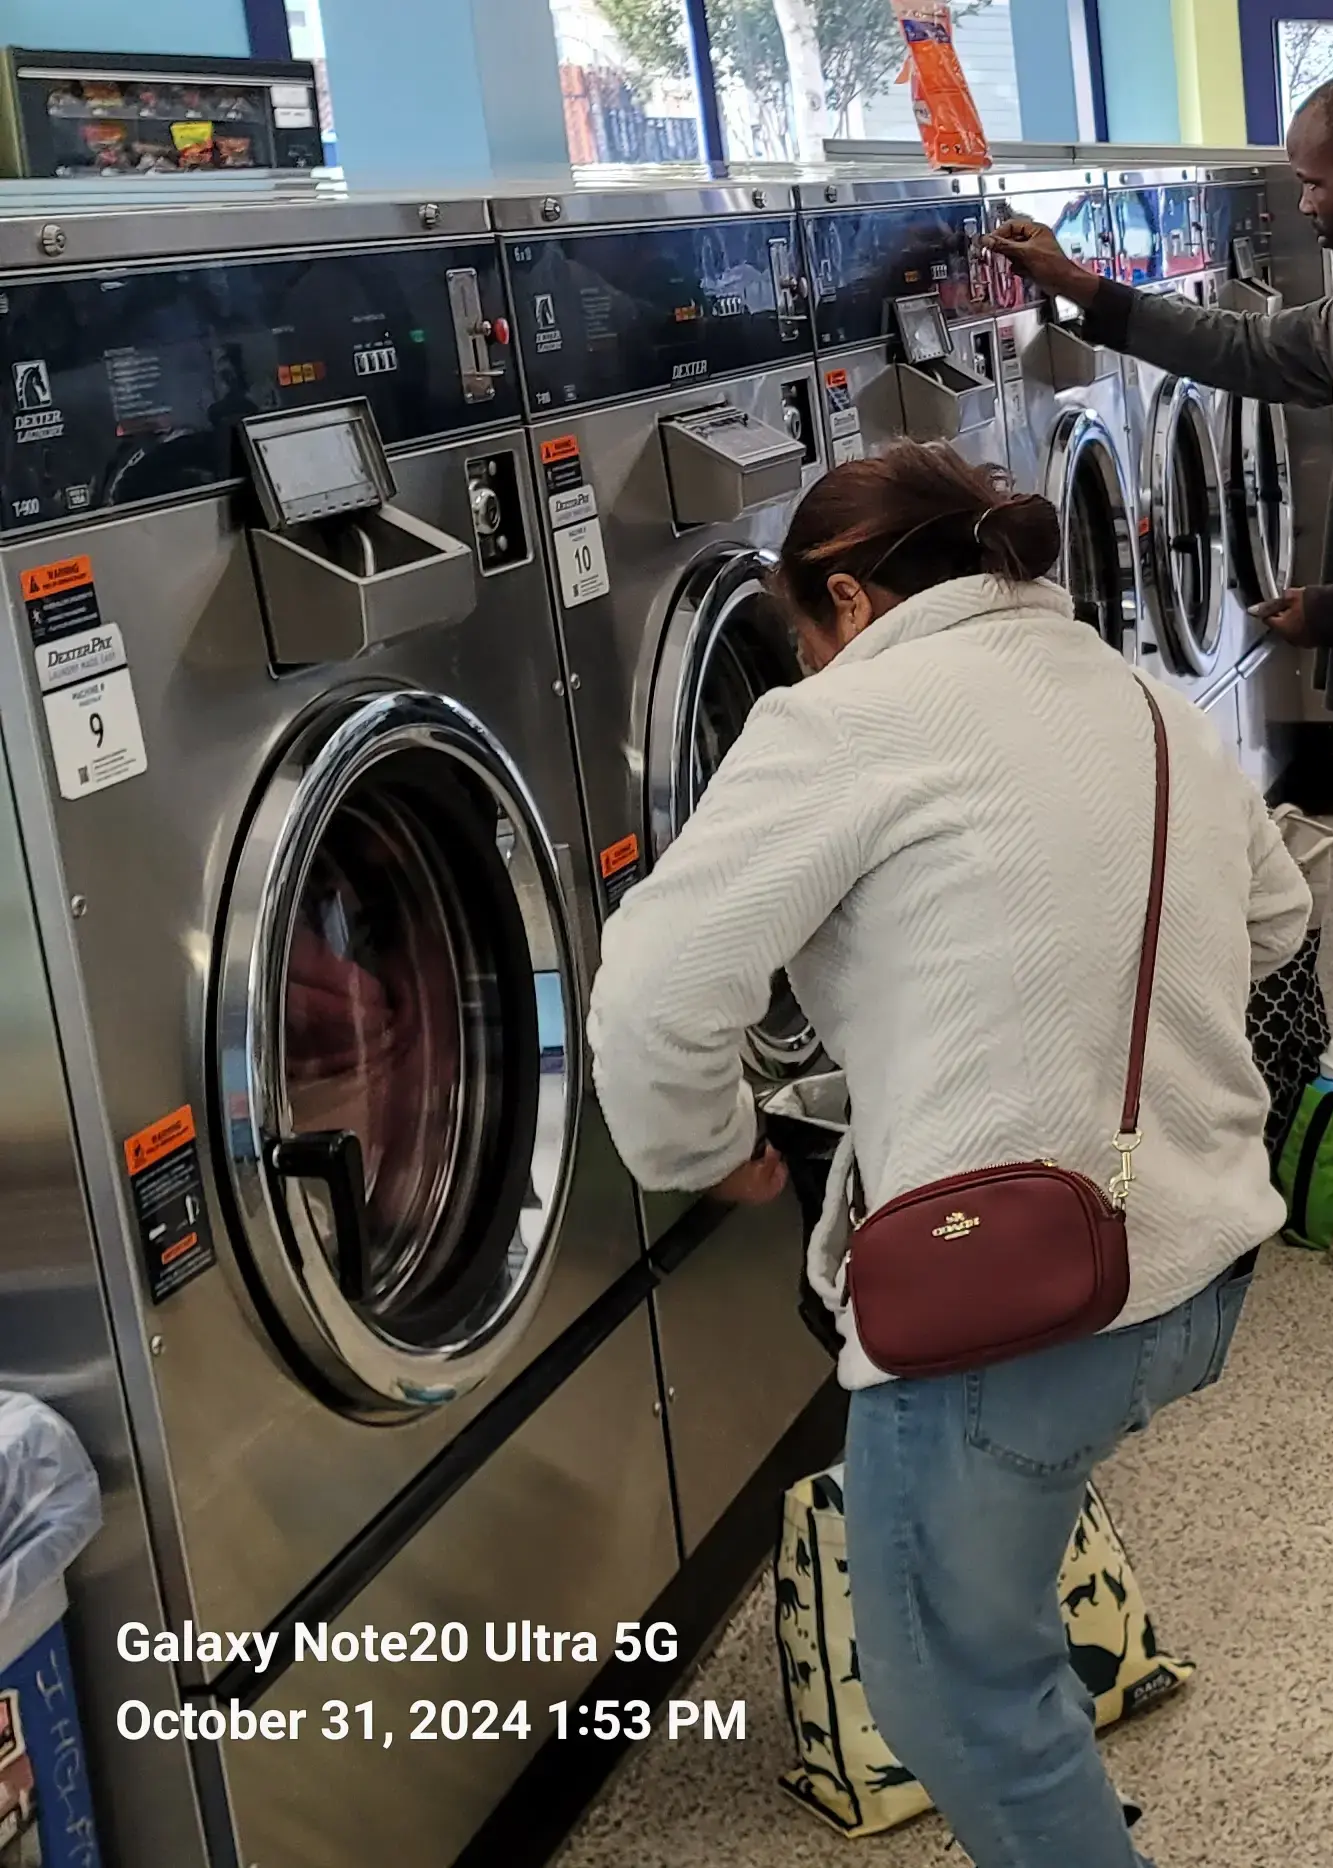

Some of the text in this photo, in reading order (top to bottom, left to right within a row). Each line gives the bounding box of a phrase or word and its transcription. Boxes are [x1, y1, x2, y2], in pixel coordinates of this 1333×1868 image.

[672, 360, 707, 380] DEXTER
[14, 410, 63, 430] DEXTER
[574, 545, 592, 574] 10
[89, 713, 104, 748] 9
